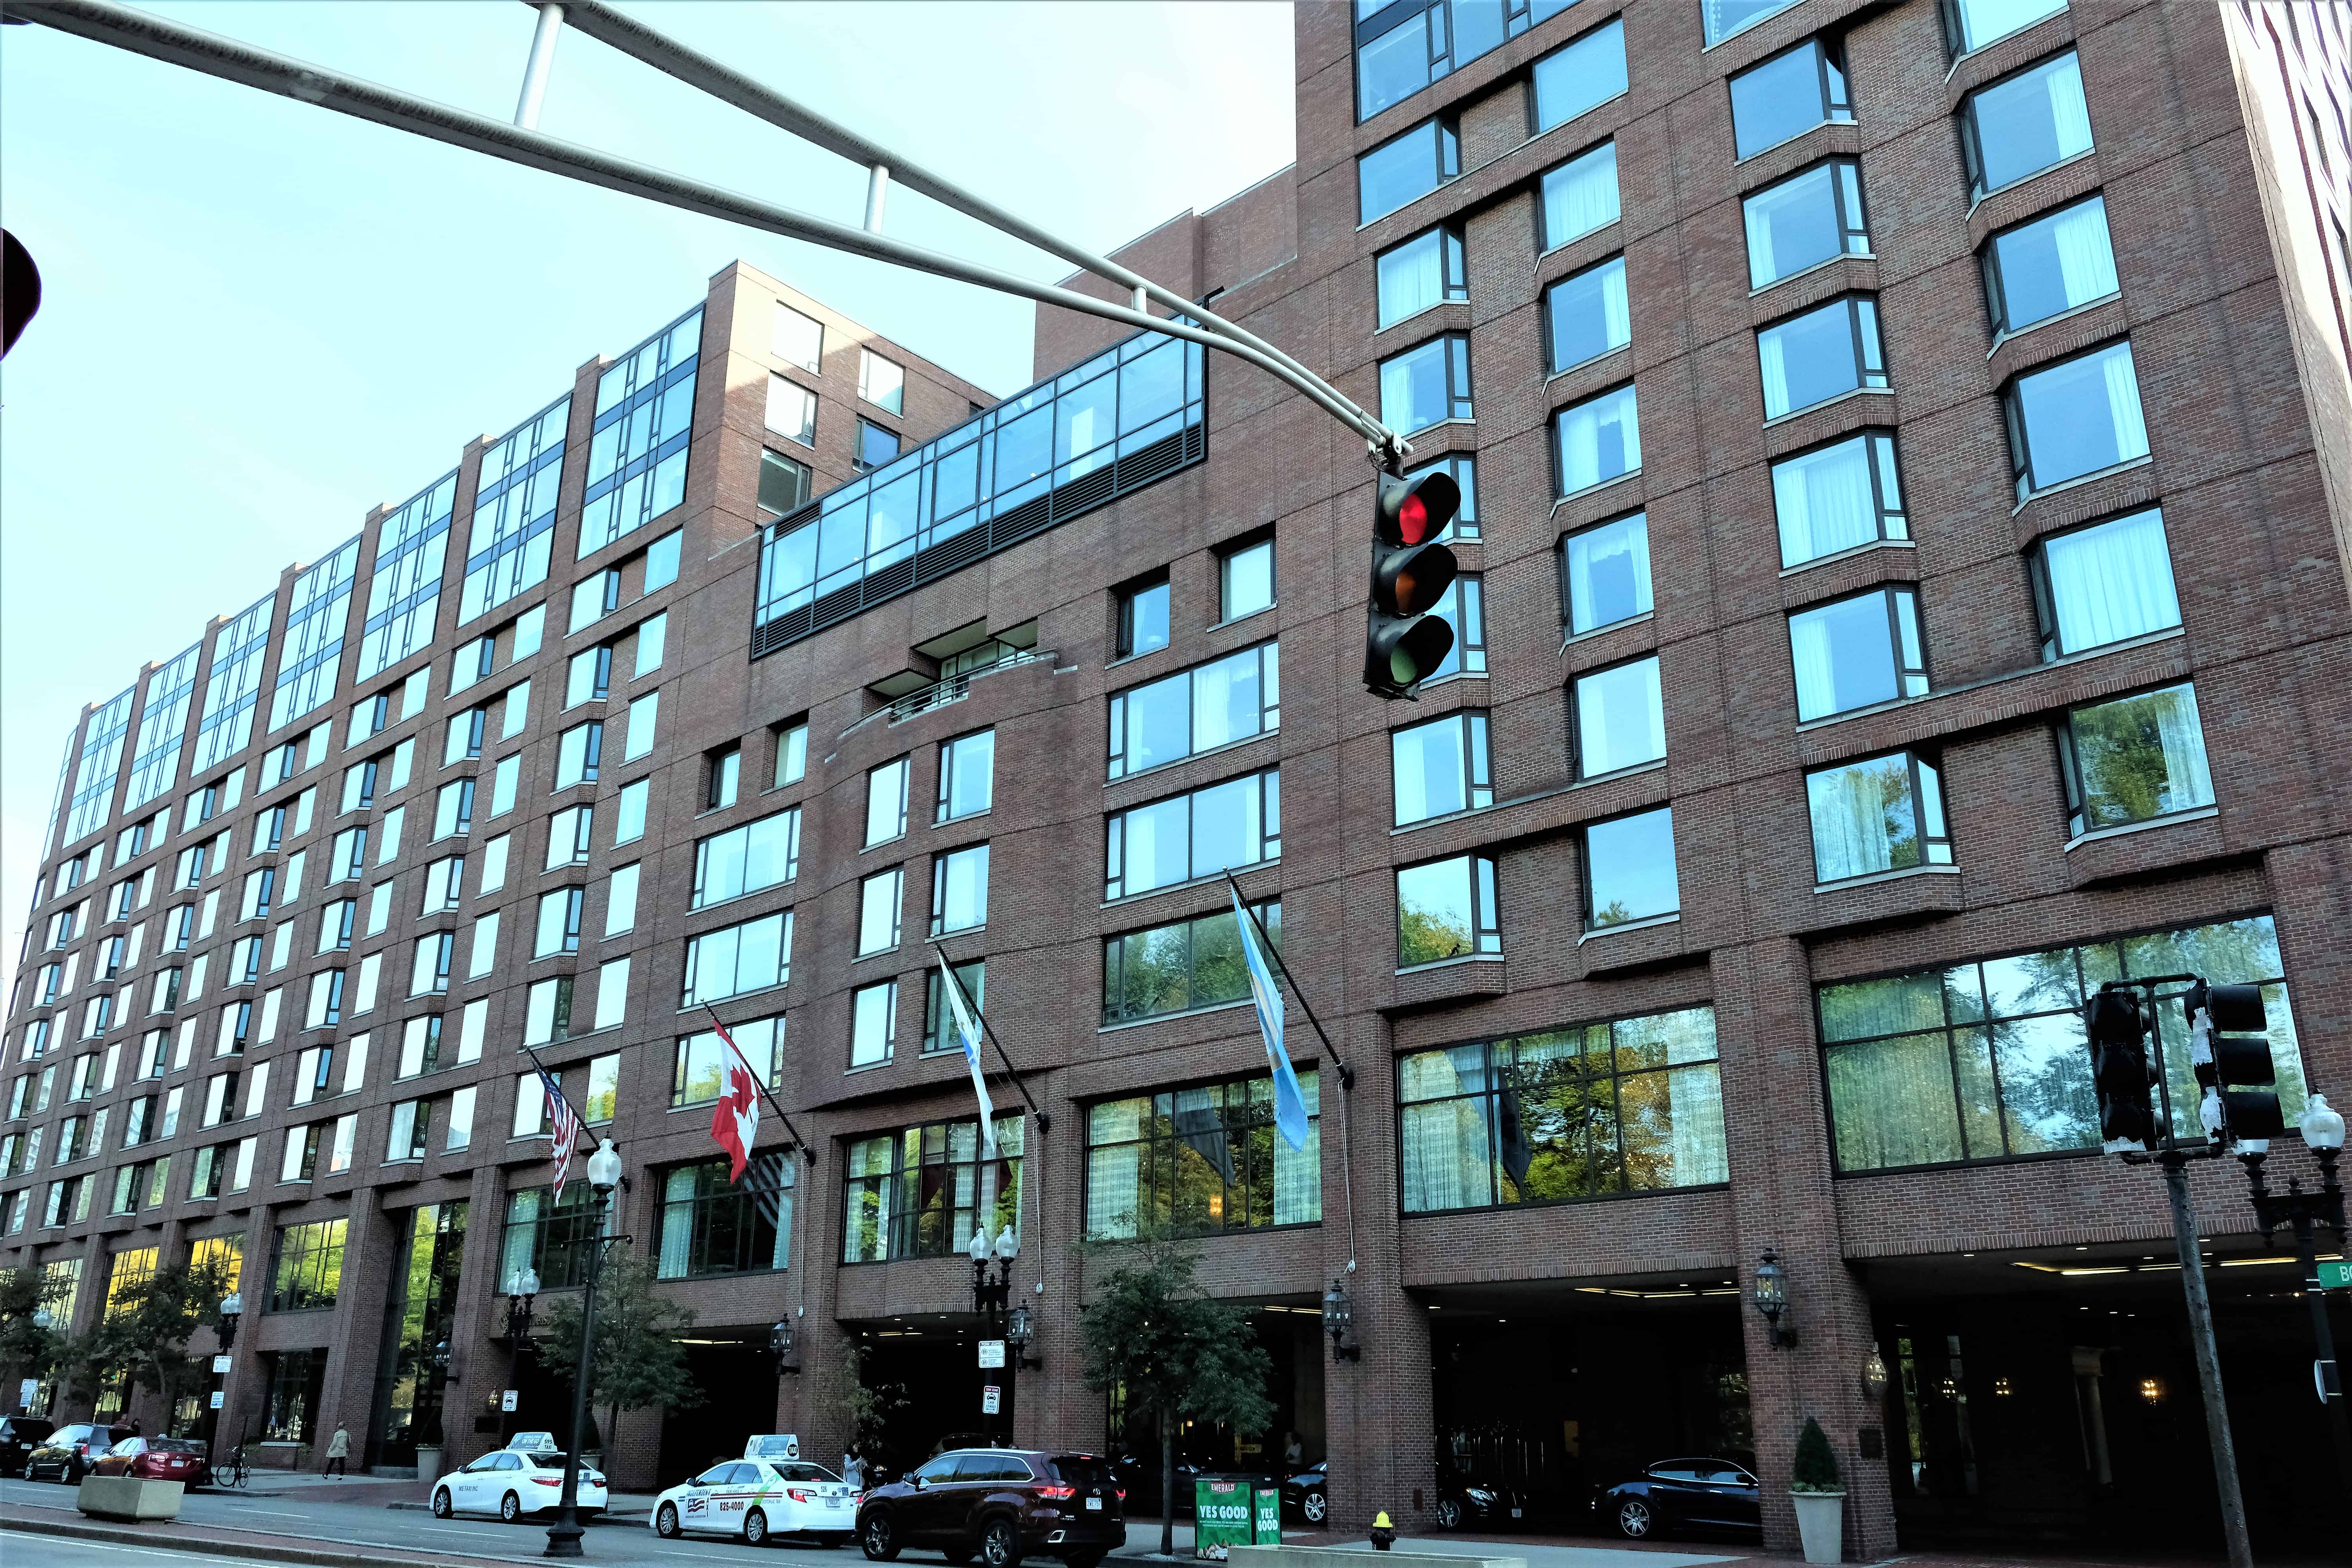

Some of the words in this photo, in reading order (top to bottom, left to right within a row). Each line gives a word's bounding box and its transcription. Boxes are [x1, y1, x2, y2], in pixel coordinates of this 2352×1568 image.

[1211, 1484, 1234, 1493] EMERALD
[720, 1501, 744, 1511] 825-4000
[1200, 1505, 1217, 1518] YES
[1219, 1506, 1248, 1519] GOOD
[1260, 1507, 1274, 1519] YES
[1257, 1519, 1278, 1532] GOOD
